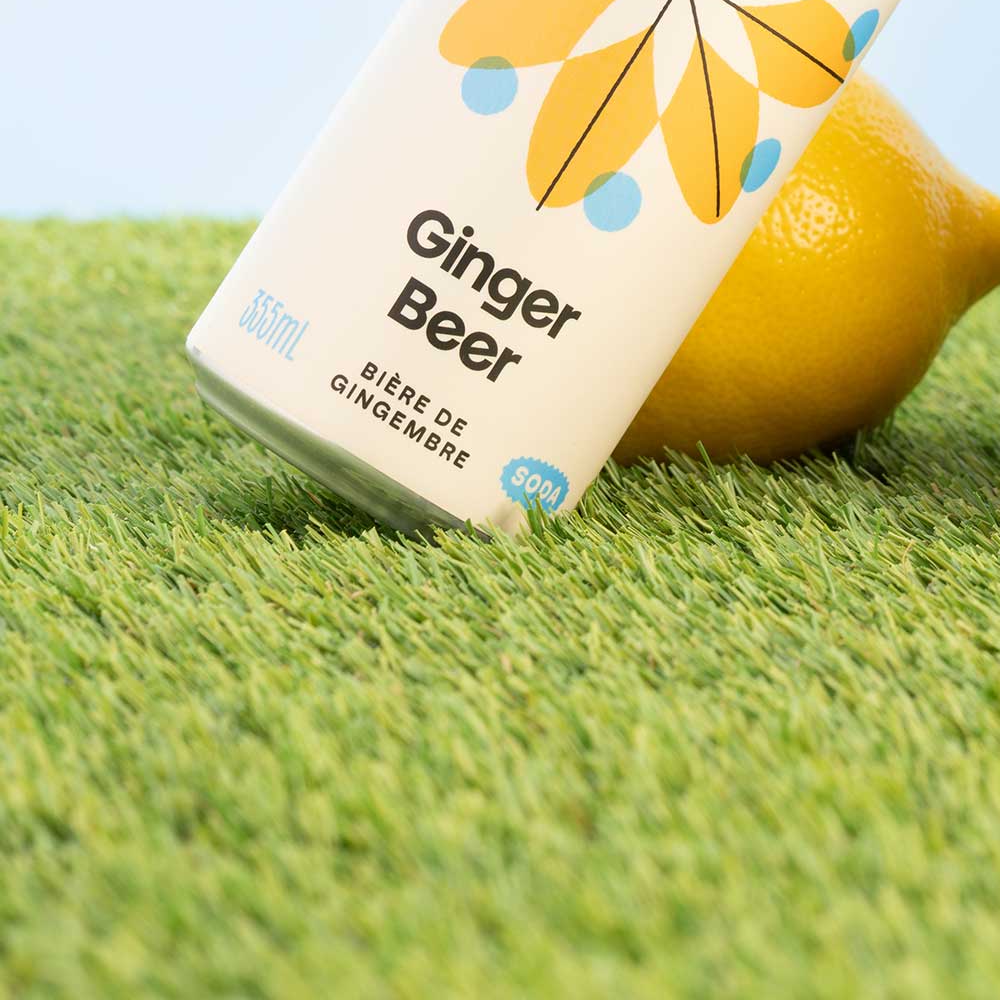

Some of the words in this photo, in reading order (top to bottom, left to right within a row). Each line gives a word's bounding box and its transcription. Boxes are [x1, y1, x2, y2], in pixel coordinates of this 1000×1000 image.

[406, 209, 582, 339] Ginger
[387, 276, 522, 382] Beer
[330, 374, 470, 469] GINGEMBRE
[360, 361, 431, 414] BIÈRE
[435, 407, 468, 437] DE
[511, 466, 561, 505] SODA
